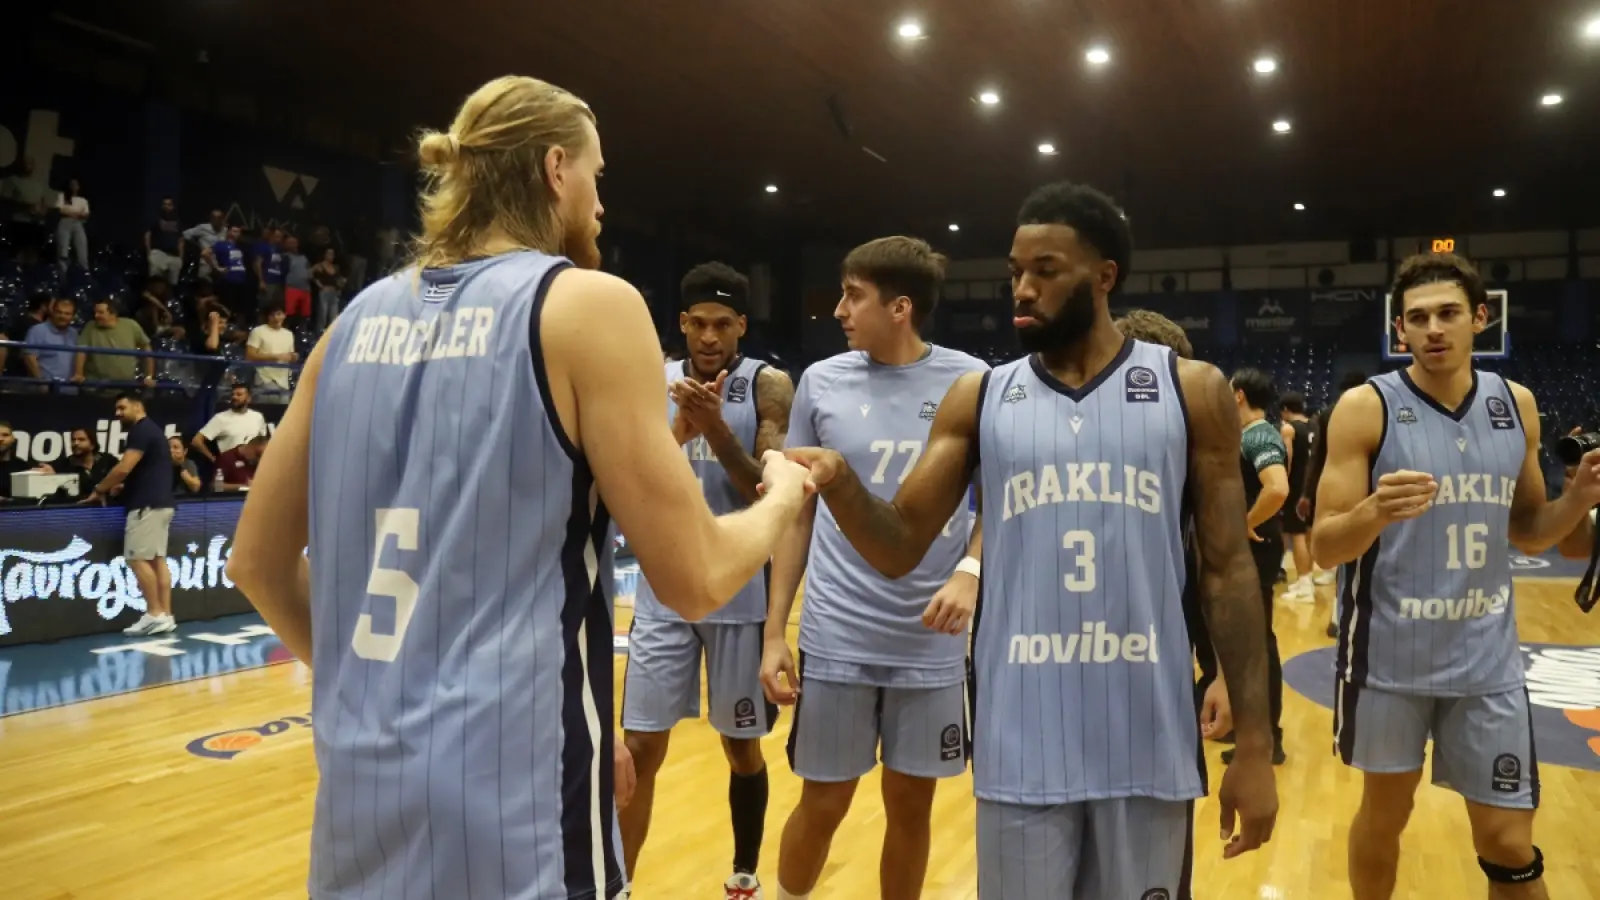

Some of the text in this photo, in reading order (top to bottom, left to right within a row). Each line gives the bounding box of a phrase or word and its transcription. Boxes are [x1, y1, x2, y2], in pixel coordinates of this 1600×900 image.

[870, 440, 922, 484] 77
[1002, 462, 1162, 521] IRAKLIS
[1428, 473, 1517, 509] AKLIS
[1062, 529, 1097, 593] 3
[1446, 523, 1489, 570] 16
[351, 507, 420, 662] 5
